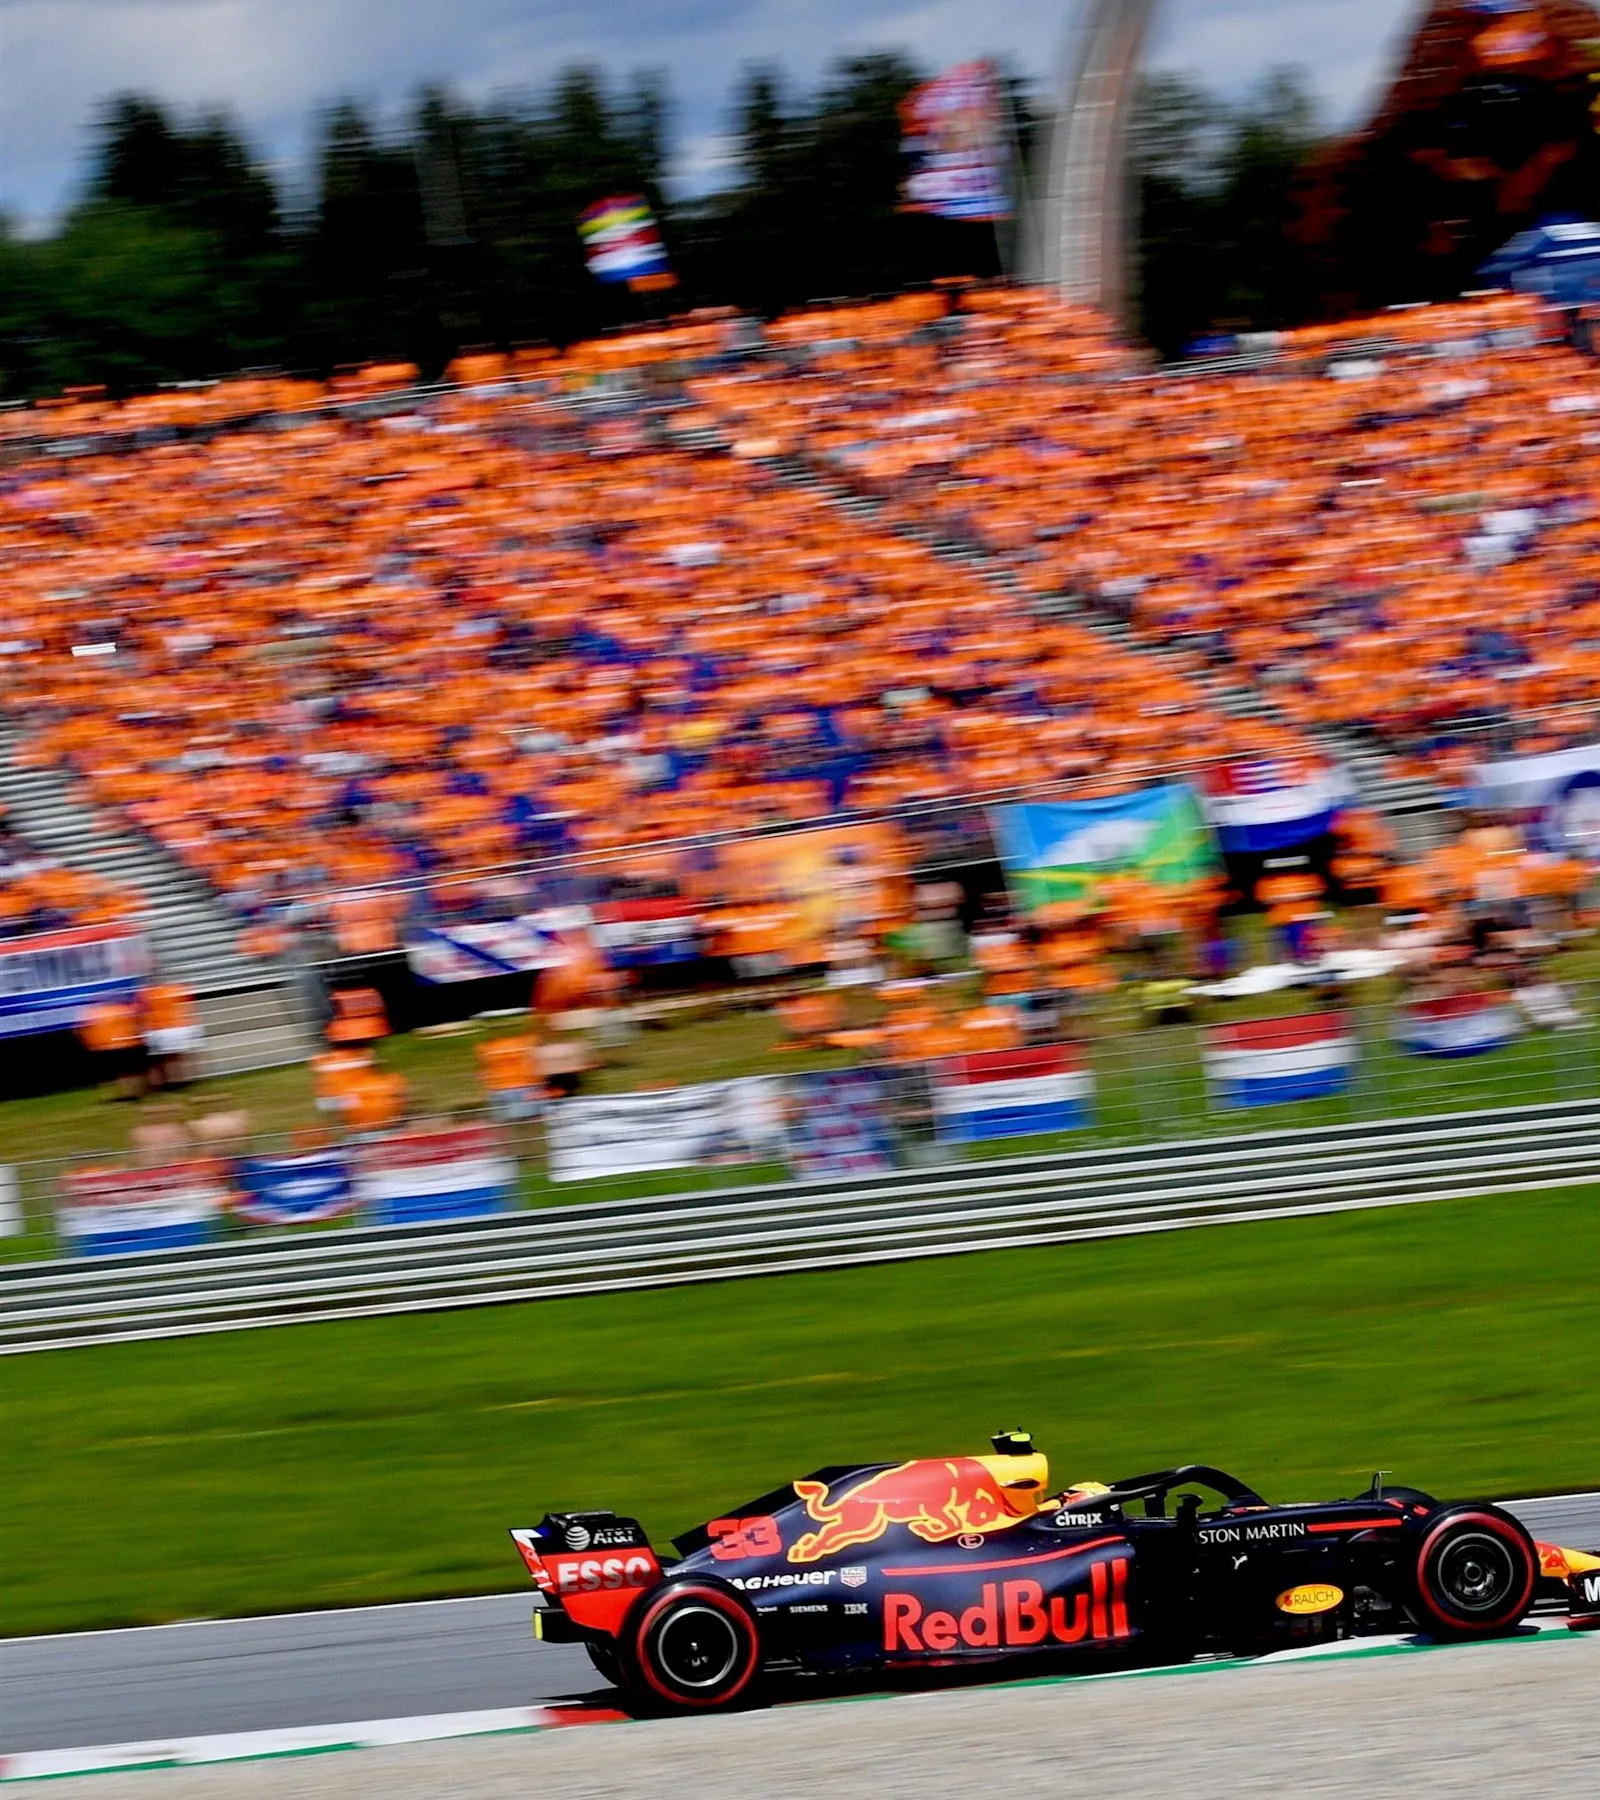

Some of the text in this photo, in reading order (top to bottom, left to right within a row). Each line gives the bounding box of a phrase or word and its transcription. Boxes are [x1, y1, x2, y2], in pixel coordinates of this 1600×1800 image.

[593, 1527, 636, 1545] AT&T
[707, 1515, 782, 1560] 33
[1193, 1522, 1306, 1545] STON MARTIN
[558, 1556, 651, 1593] ESSO
[1294, 1590, 1334, 1606] RAUCH
[789, 1604, 829, 1614] SIEMENS
[843, 1603, 869, 1615] IBM
